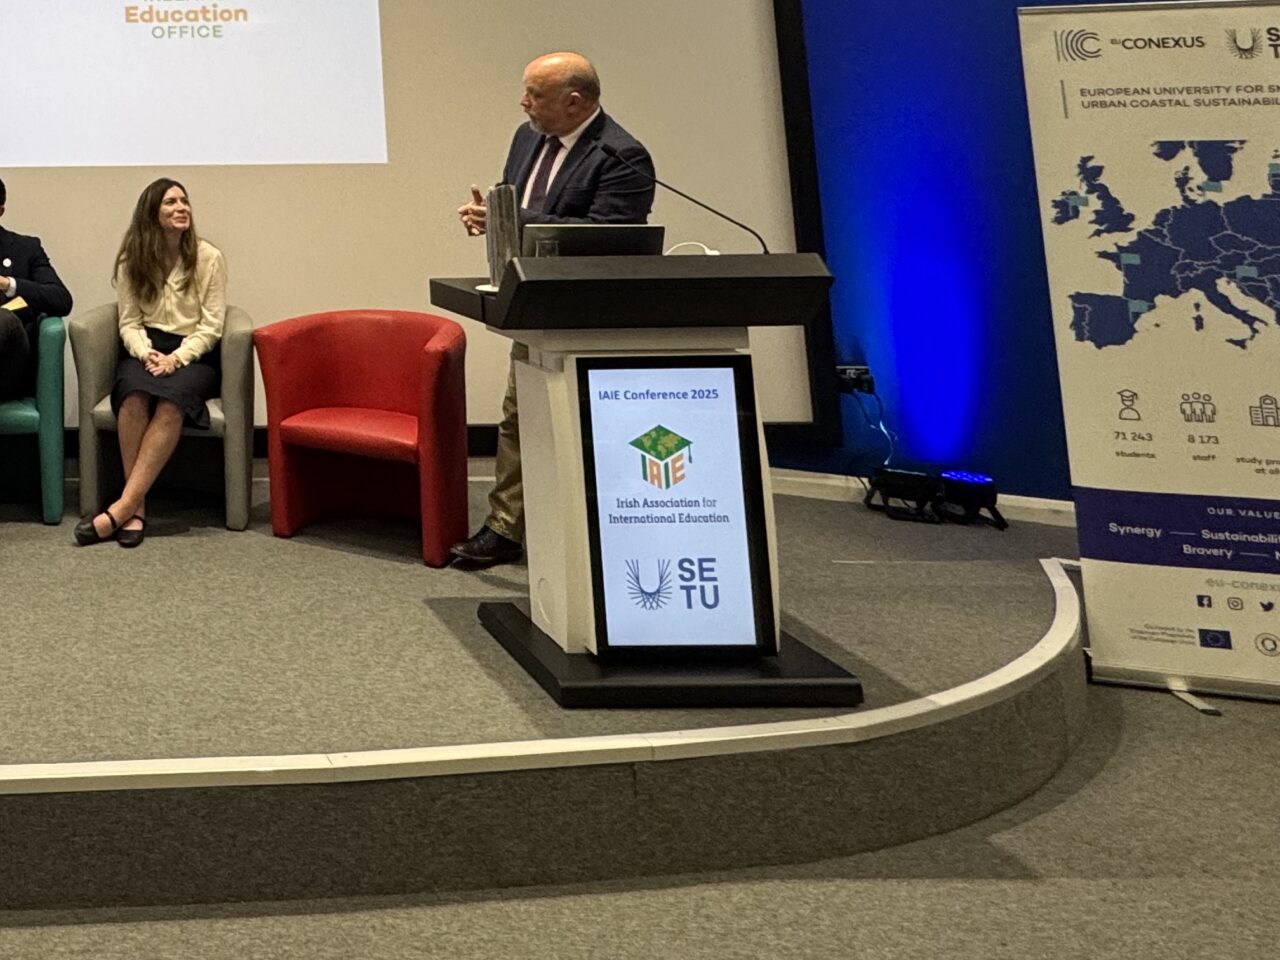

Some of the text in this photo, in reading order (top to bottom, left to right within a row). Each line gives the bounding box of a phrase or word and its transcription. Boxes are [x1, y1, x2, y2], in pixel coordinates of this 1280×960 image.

[125, 3, 248, 24] Education
[151, 25, 224, 39] OFFICE
[1121, 35, 1206, 50] CONEXUS
[1080, 86, 1151, 97] EUROPEAN
[1153, 85, 1232, 96] UNIVERSITY
[1235, 84, 1264, 94] FOR
[1081, 100, 1127, 109] URBAN
[1129, 98, 1190, 108] COASTAL
[598, 389, 719, 400] IAIE Conference 2025
[1131, 432, 1153, 442] 243
[1187, 434, 1219, 445] 8 173
[616, 497, 717, 508] Irish Association for
[1207, 506, 1234, 516] OUR
[608, 512, 730, 524] International Education
[1108, 522, 1163, 538] Synergy
[1182, 544, 1233, 559] Bravery
